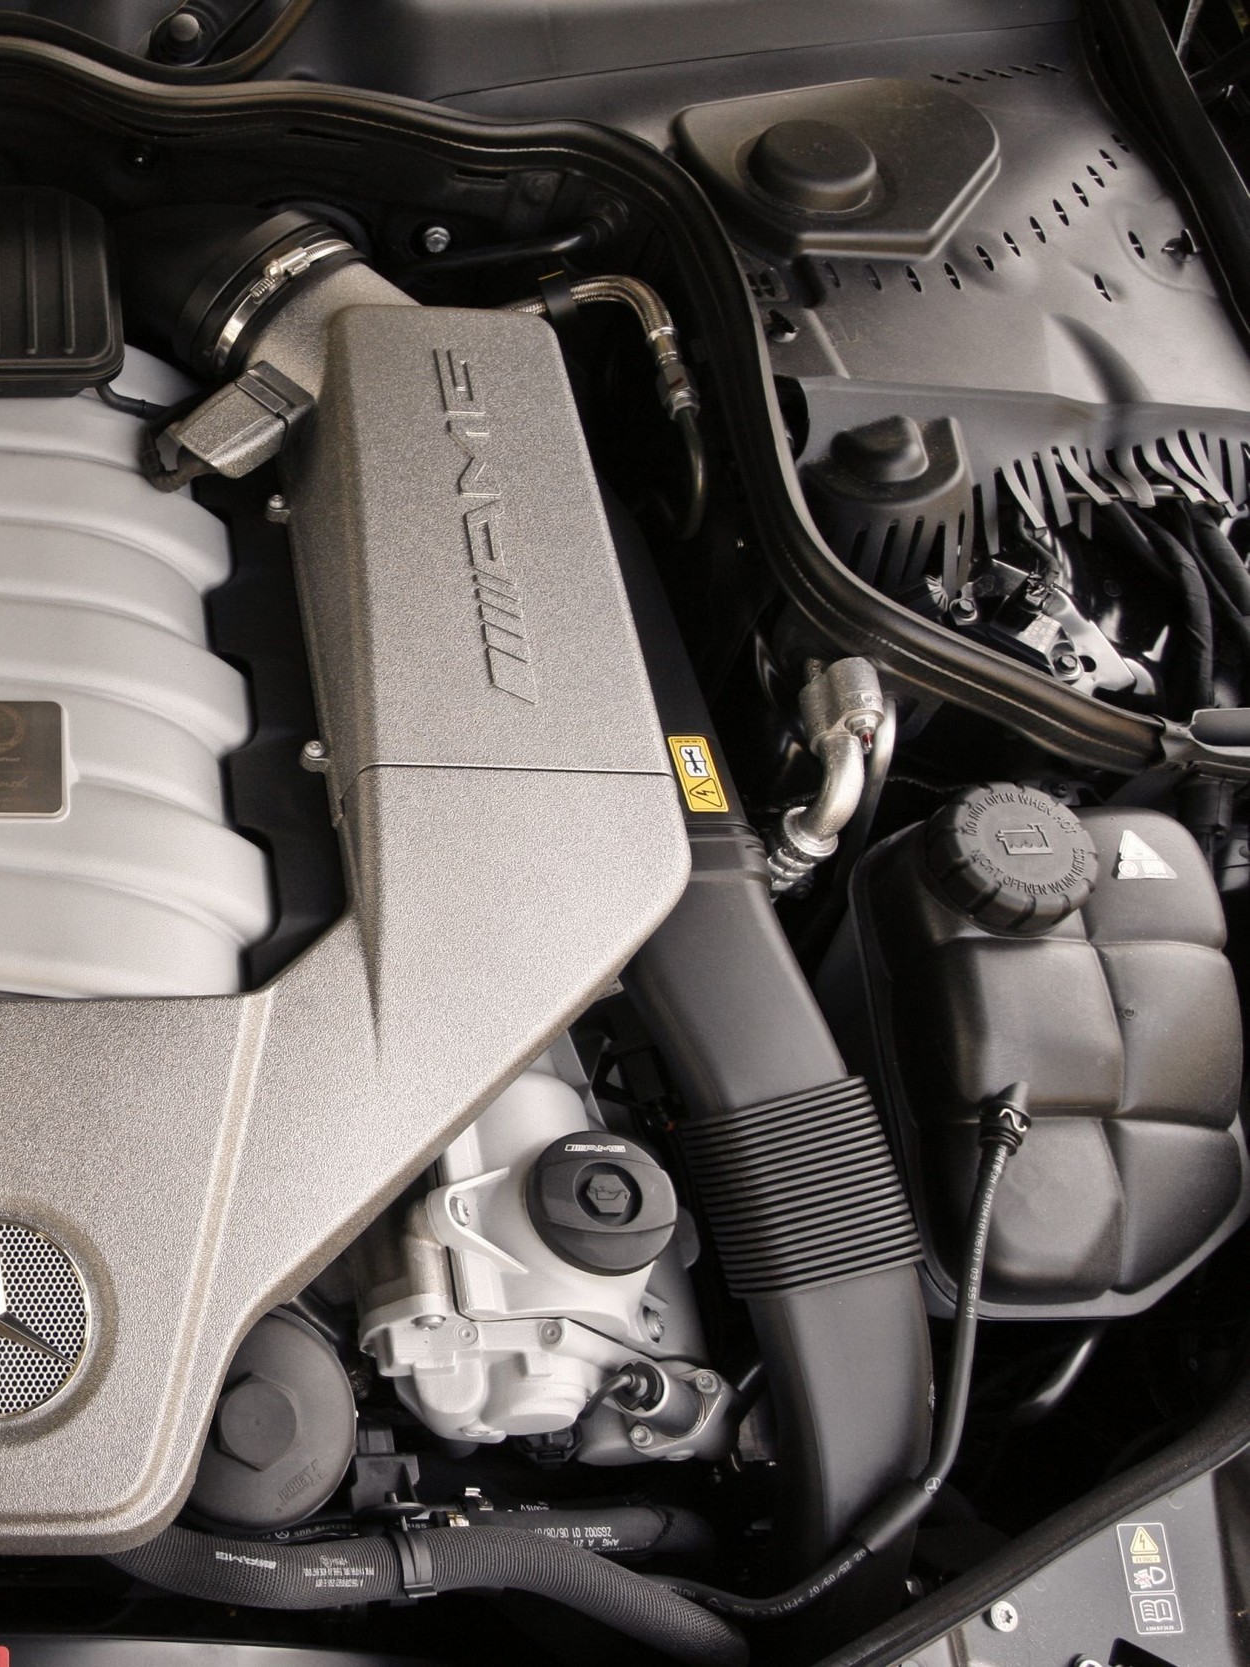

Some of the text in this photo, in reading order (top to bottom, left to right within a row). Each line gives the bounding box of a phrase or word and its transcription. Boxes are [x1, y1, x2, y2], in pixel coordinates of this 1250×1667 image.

[434, 348, 517, 588] AMG
[964, 793, 1077, 836] DO NOT OPEN WHEN HOT
[970, 849, 1003, 878] NICHT
